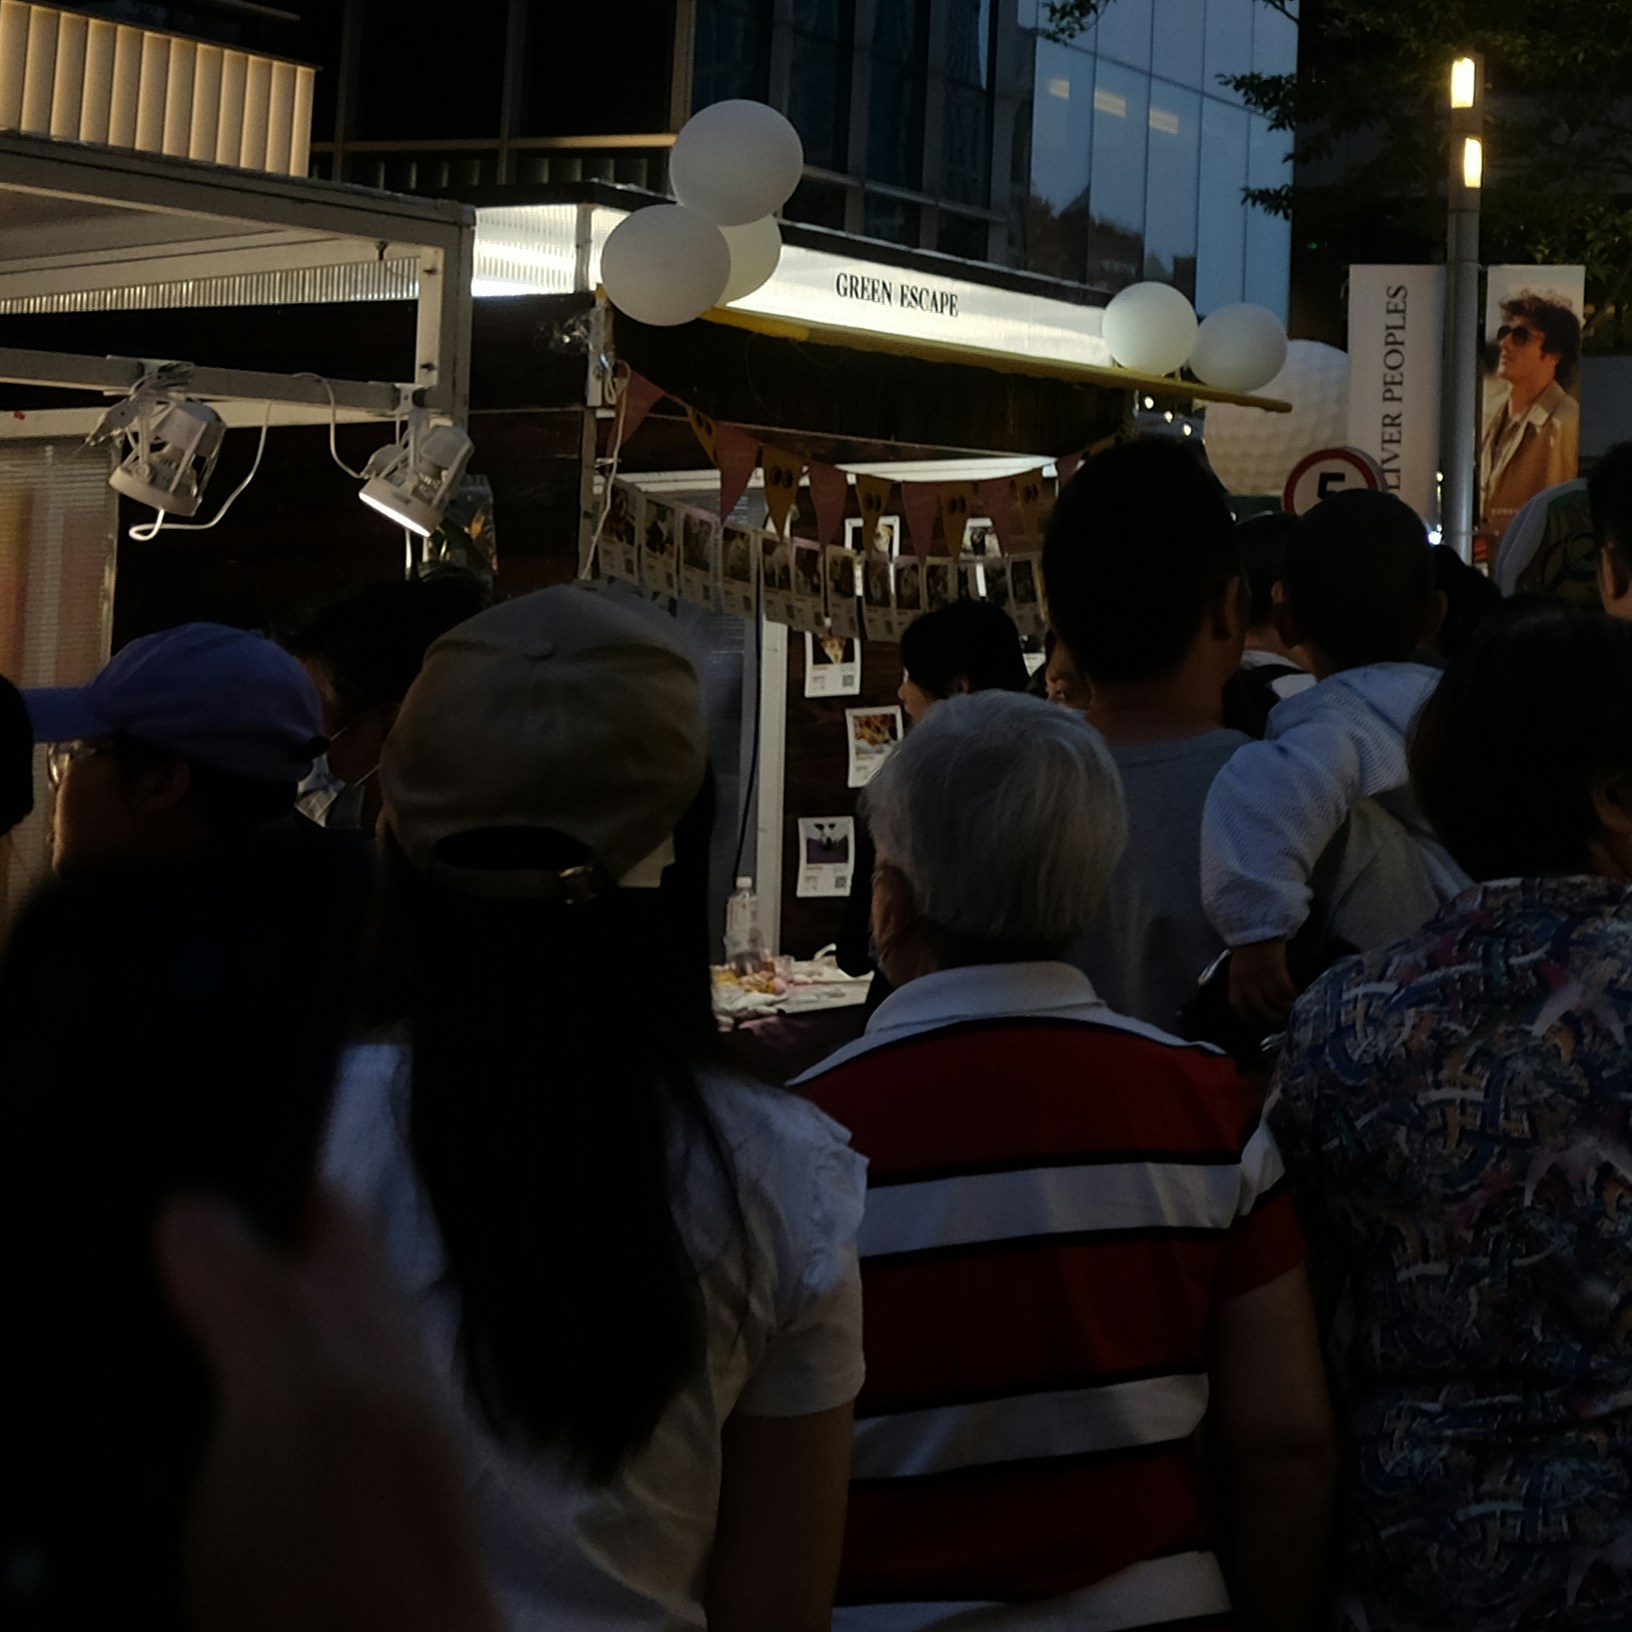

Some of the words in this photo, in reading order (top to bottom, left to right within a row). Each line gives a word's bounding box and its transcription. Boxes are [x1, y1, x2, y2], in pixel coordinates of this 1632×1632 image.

[836, 272, 892, 306] GREEN
[900, 283, 959, 317] ESCAPE
[1382, 284, 1408, 404] PEOPLES
[1380, 412, 1403, 492] LIVER
